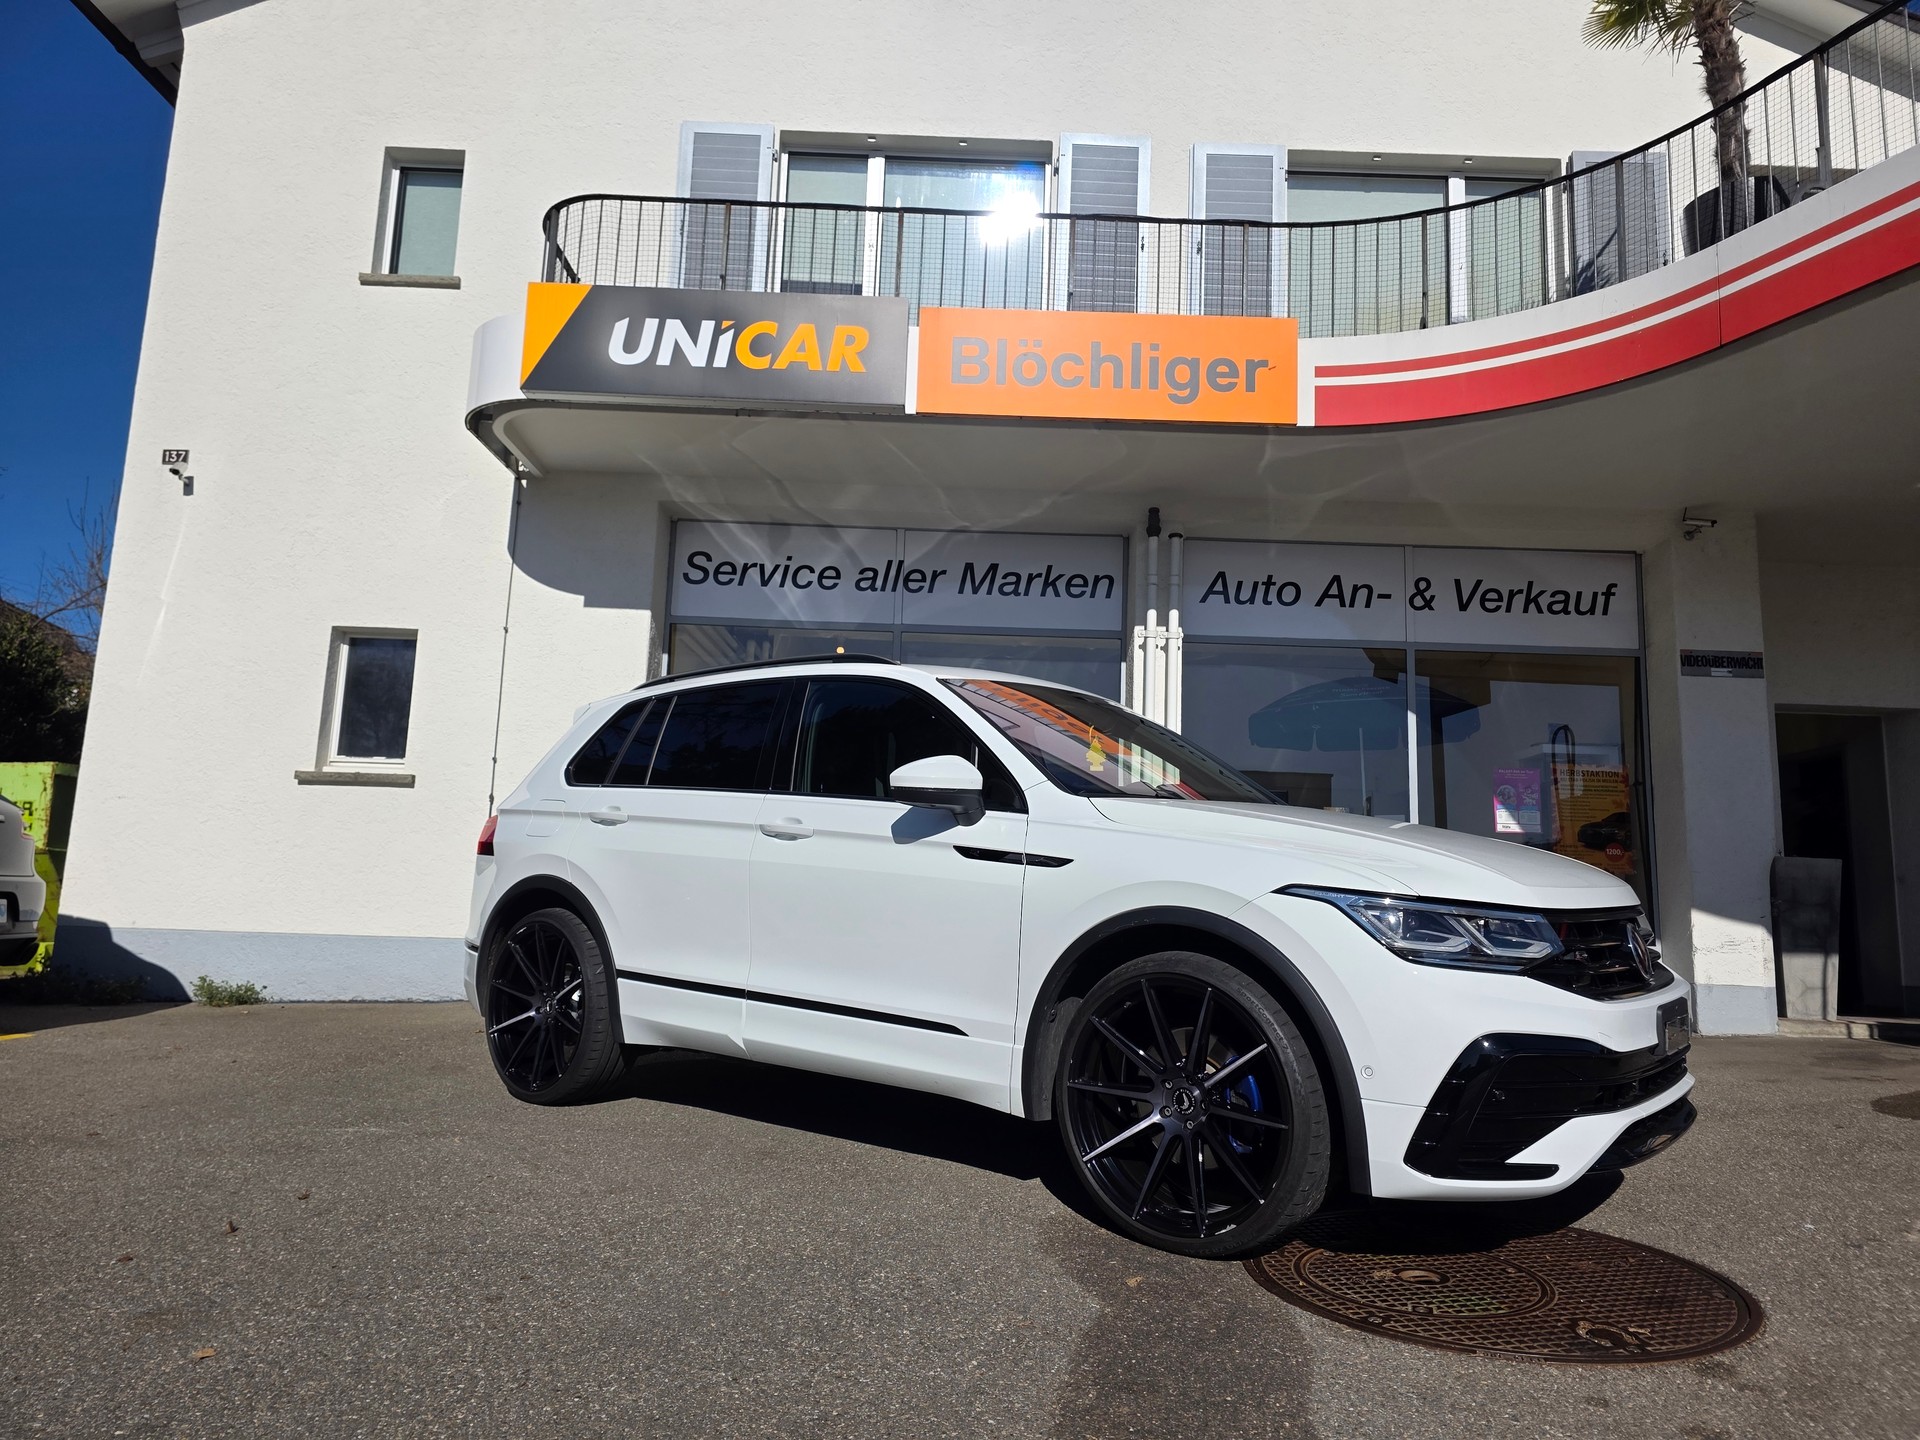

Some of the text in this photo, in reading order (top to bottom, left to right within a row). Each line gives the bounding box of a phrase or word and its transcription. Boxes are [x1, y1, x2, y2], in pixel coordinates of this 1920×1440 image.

[951, 336, 1269, 405] Blöchliger
[165, 450, 186, 462] 137
[682, 550, 1116, 599] Service aller Marken
[1199, 570, 1619, 616] Auto An- & Verkauf
[1559, 768, 1620, 778] HERBSTAKTION
